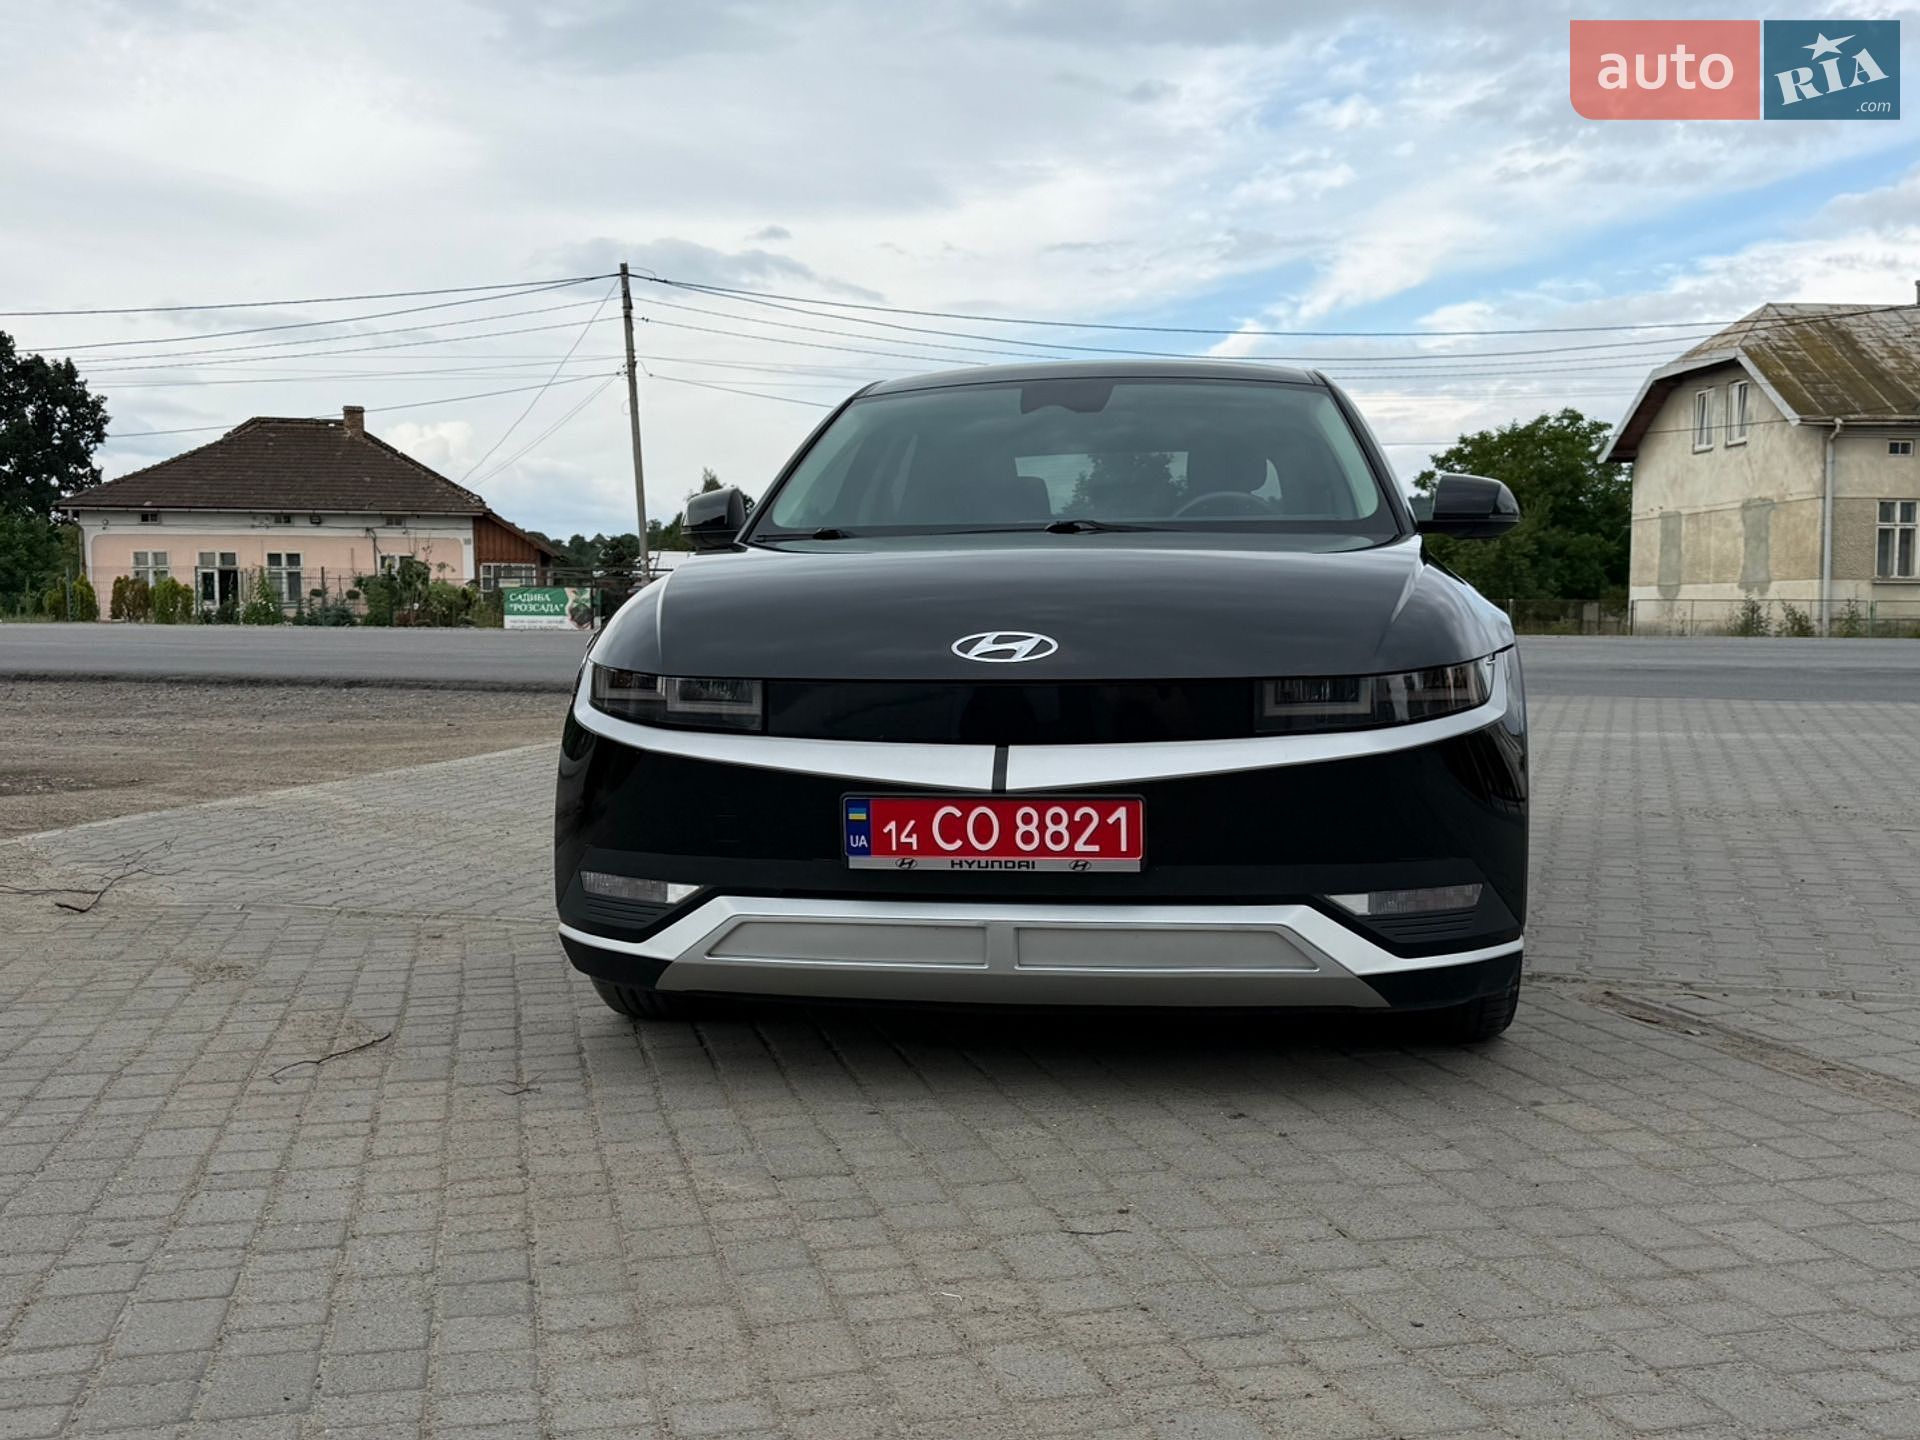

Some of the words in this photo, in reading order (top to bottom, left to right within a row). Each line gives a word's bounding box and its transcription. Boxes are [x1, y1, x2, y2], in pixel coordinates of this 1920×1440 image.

[509, 593, 551, 602] САДИБА
[882, 820, 918, 851] 14
[932, 806, 1000, 851] CO
[1015, 806, 1128, 852] 8821
[849, 834, 868, 848] UA
[950, 859, 1036, 870] HYUNDAI
